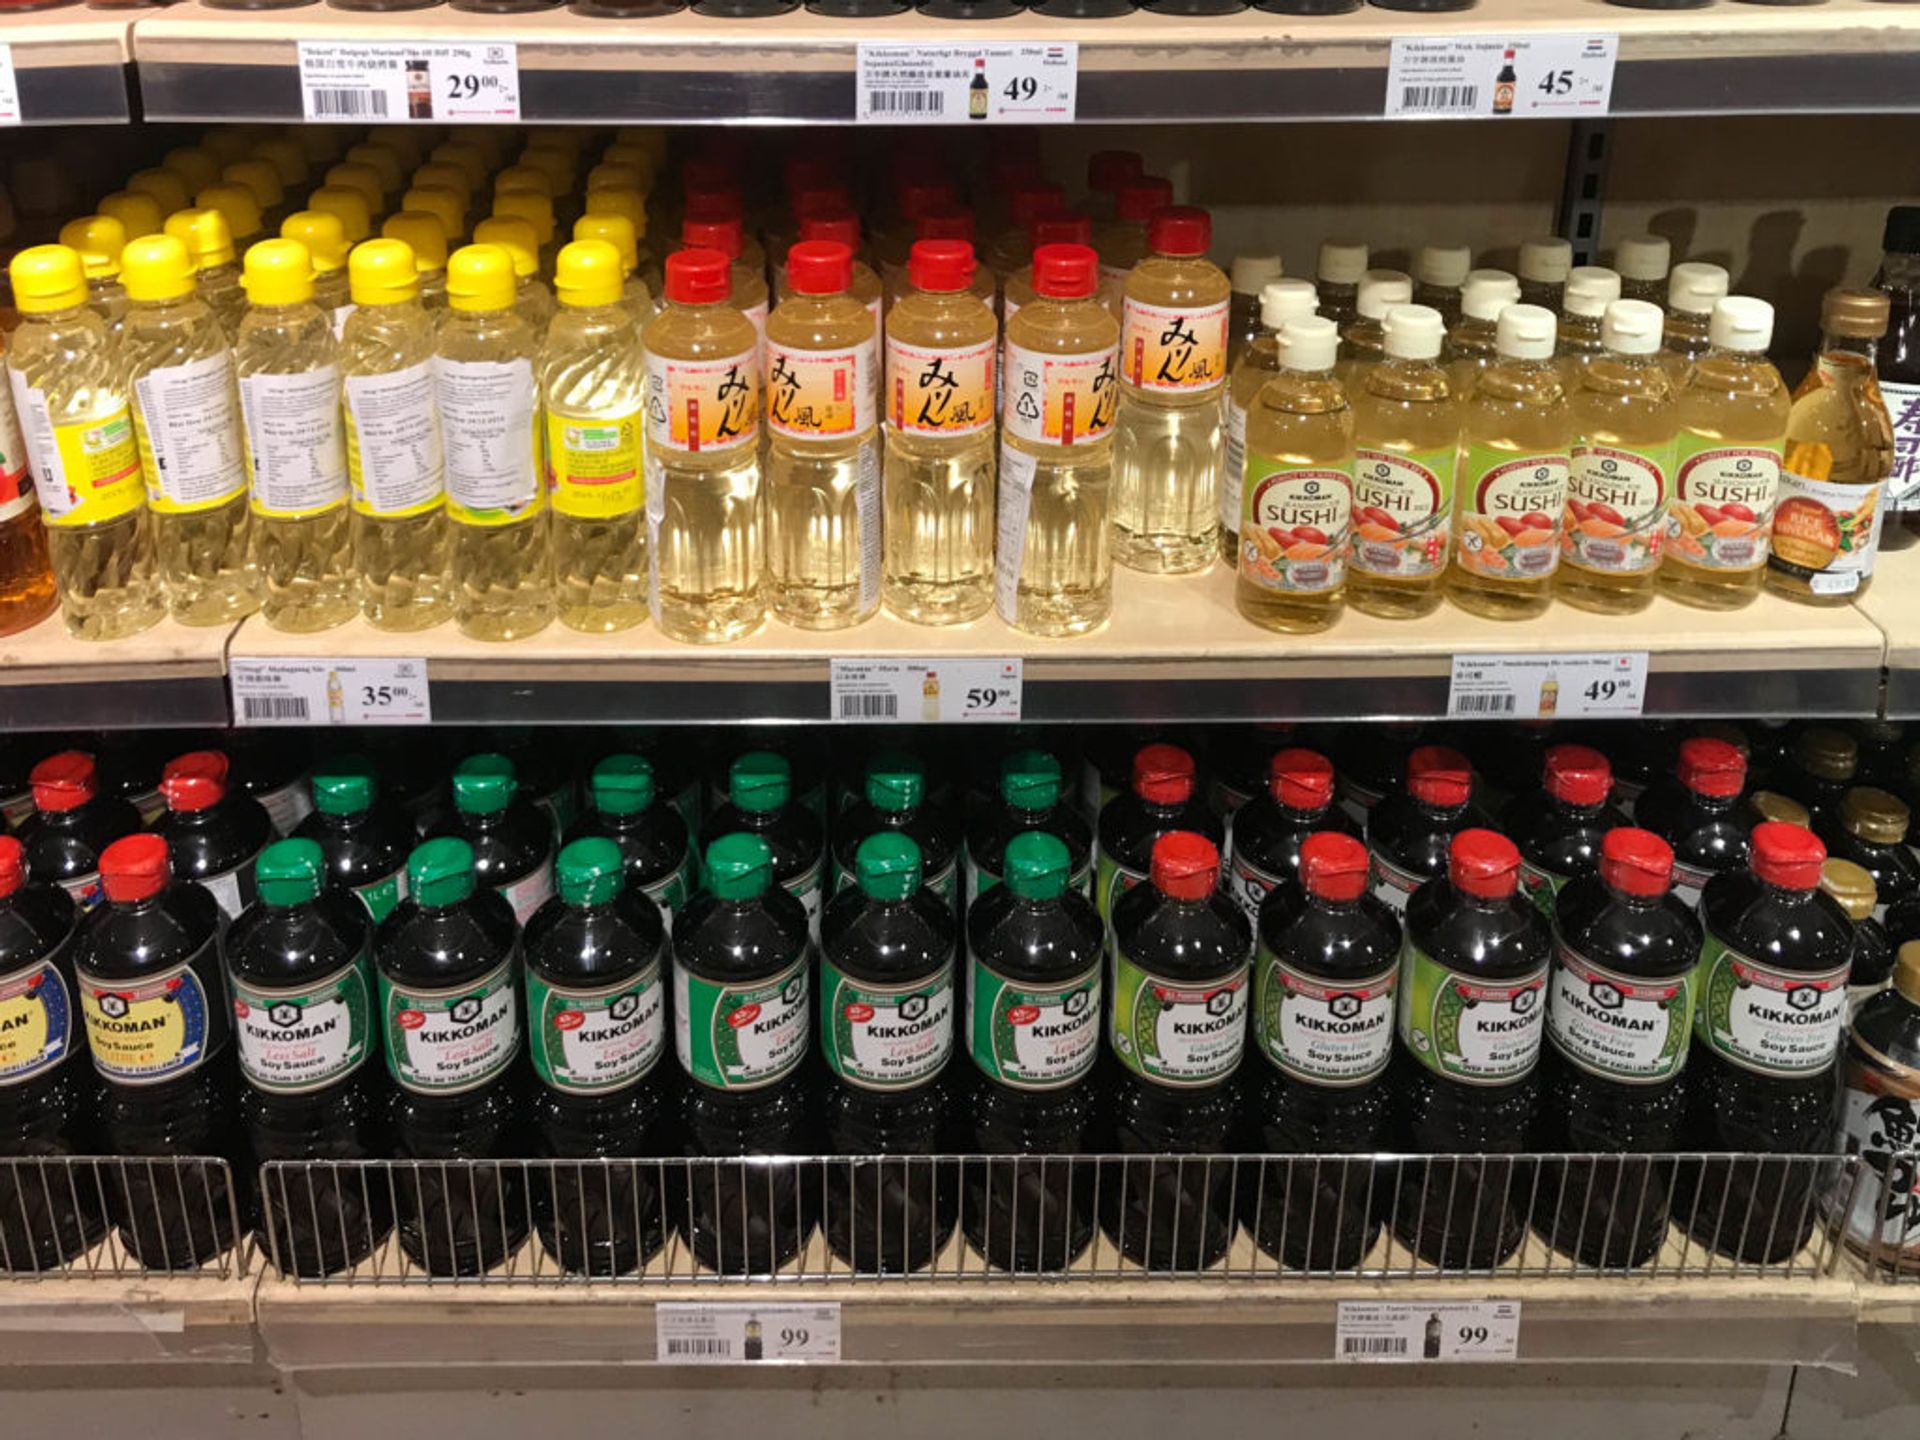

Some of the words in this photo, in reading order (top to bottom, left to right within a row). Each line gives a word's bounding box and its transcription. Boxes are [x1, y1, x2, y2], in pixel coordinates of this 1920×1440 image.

[446, 74, 480, 99] 29
[1003, 76, 1038, 101] 49
[1538, 70, 1574, 95] 45
[1356, 484, 1410, 511] USHI
[1567, 476, 1636, 506] SUSHI
[1694, 482, 1767, 502] SUSHI
[1495, 492, 1561, 512] SUSHI
[1267, 505, 1337, 525] SUSHI
[361, 686, 392, 706] 35
[965, 688, 998, 709] 59
[1583, 679, 1617, 701] 49
[1561, 986, 1654, 1031] KIKKOMAN
[1749, 1003, 1840, 1025] KIKKOMAN
[86, 1012, 166, 1033] IKKOMAN
[246, 1018, 337, 1041] KIKKOMAN
[420, 1004, 508, 1042] KIKKOMAN
[579, 997, 659, 1042] KIKKOMAN
[867, 1003, 948, 1038] KIKKOMAN
[1295, 1012, 1384, 1034] KIKKOMAN
[1308, 1048, 1332, 1061] Soy
[1489, 1051, 1512, 1060] Soy
[1592, 1039, 1635, 1058] Sauce
[1760, 1039, 1786, 1053] Soy
[260, 1058, 281, 1070] Soy
[436, 1061, 460, 1070] Soy
[595, 1060, 618, 1070] Soy
[881, 1057, 905, 1067] Soy
[1046, 1056, 1067, 1065] Soy
[1187, 1054, 1210, 1063] Soy
[780, 1327, 810, 1346] 99
[1458, 1326, 1488, 1345] 99
